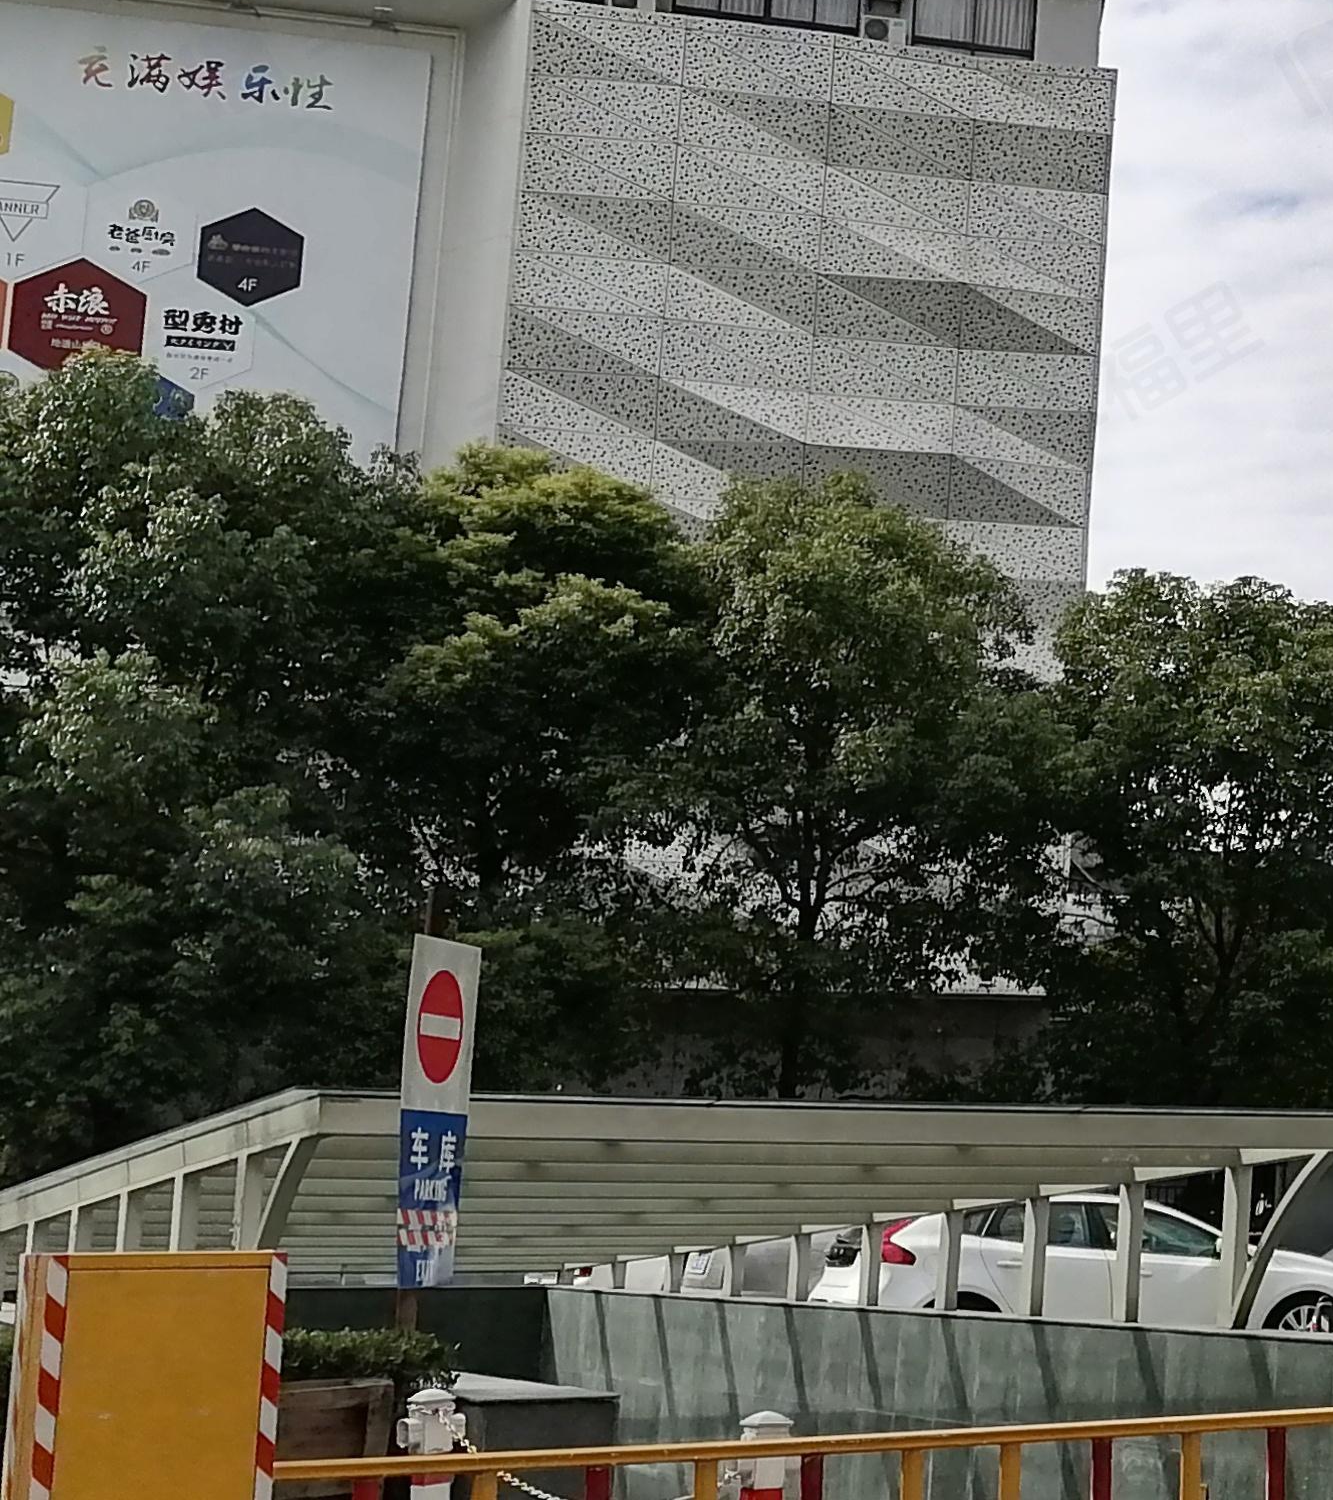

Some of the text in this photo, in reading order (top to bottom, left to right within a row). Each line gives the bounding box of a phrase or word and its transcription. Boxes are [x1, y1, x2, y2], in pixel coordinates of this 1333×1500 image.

[78, 46, 333, 111] 充满娱乐性
[131, 260, 151, 273] 4F
[237, 278, 258, 292] 4F
[190, 367, 208, 380] 2F
[410, 1126, 457, 1174] 车库
[414, 1176, 452, 1201] PARKING
